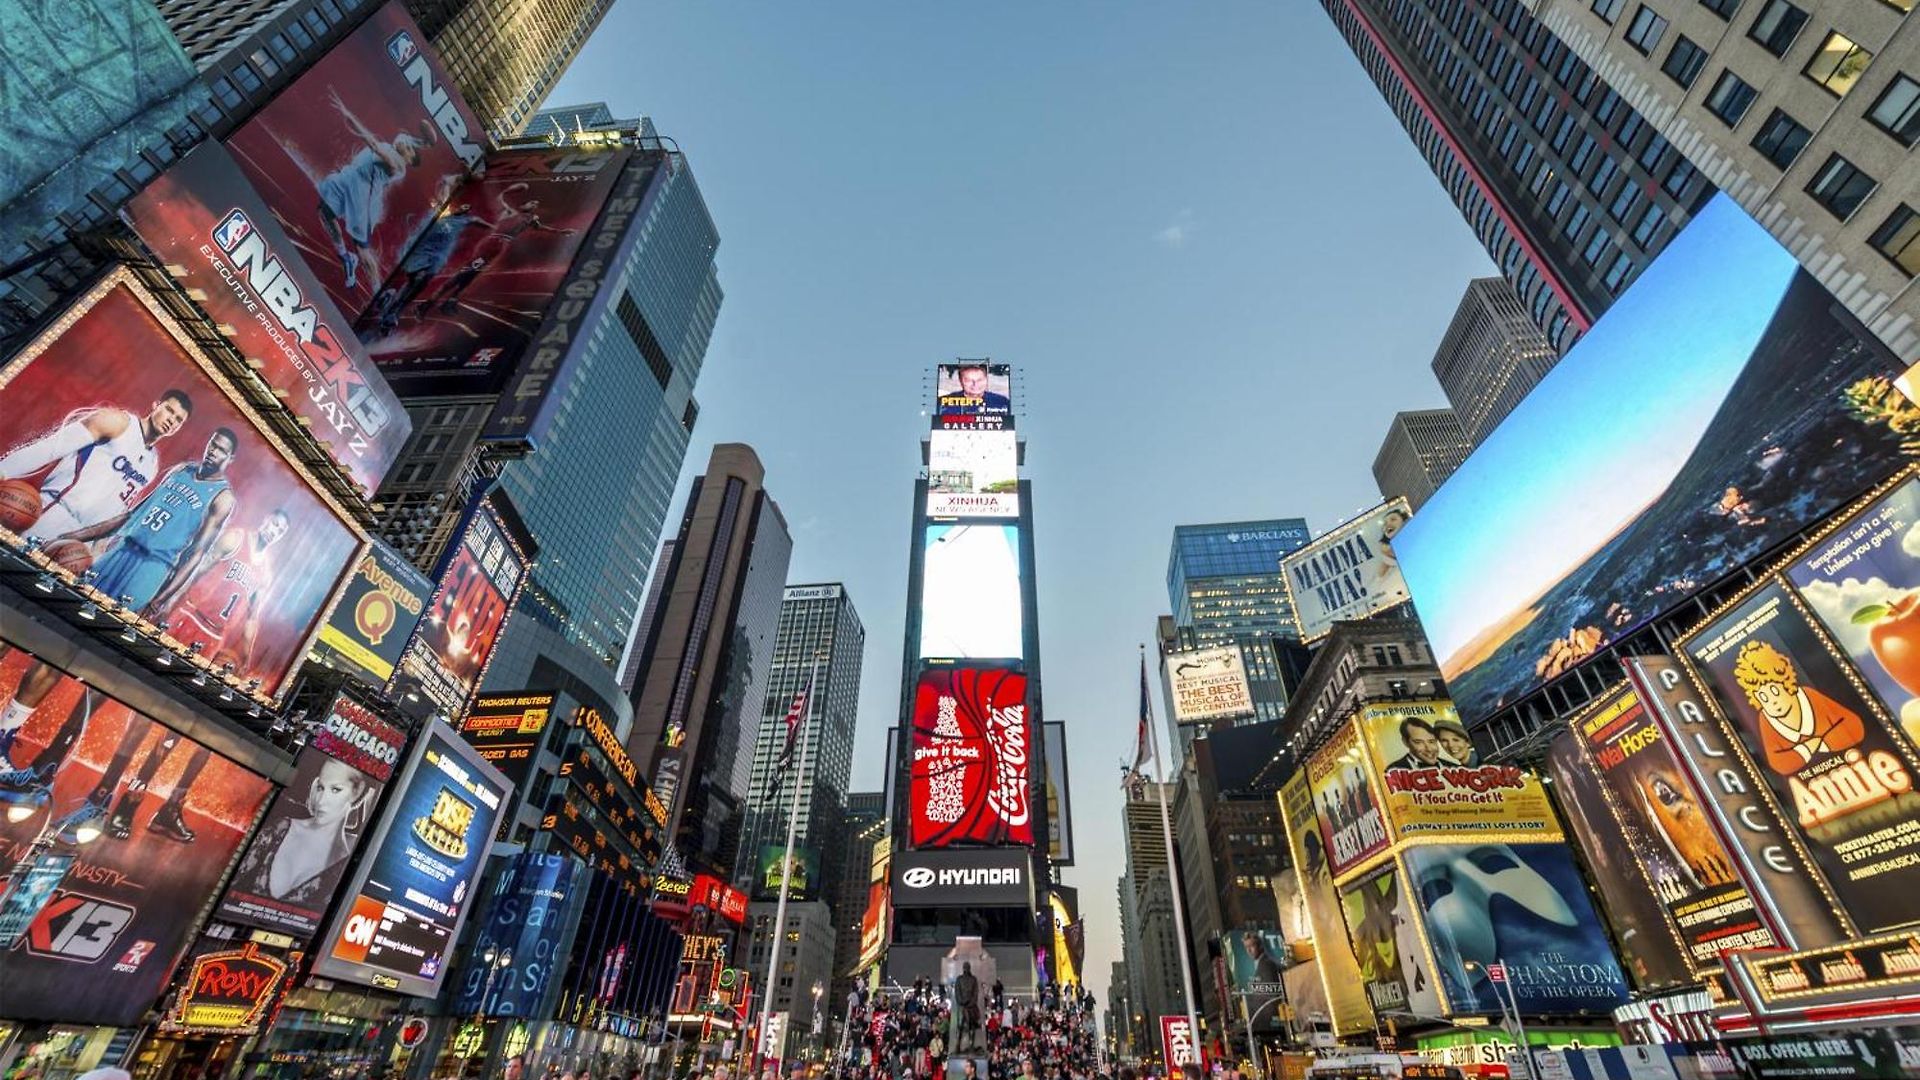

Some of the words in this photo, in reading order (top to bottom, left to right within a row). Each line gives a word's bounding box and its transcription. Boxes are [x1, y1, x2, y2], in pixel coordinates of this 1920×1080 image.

[595, 166, 654, 249] TIMES
[230, 230, 318, 343] NBA
[200, 244, 257, 313] EXECUTIVE
[255, 313, 304, 371] PRODUCED
[302, 370, 317, 382] BY
[514, 259, 604, 397] SQUARE
[941, 396, 975, 406] PETER
[309, 384, 351, 434] JAY
[348, 435, 368, 458] Z
[948, 497, 999, 506] XINHUA
[141, 507, 172, 533] 35
[1242, 528, 1302, 542] BARCLAYS
[1806, 537, 1853, 571] Temptation
[1851, 523, 1872, 541] isn't
[1292, 531, 1374, 595] MAMMA
[1823, 554, 1854, 577] Unless
[1852, 542, 1871, 561] you
[1871, 527, 1893, 549] give
[359, 555, 422, 615] Avenue
[789, 588, 820, 598] Allianz
[1316, 568, 1368, 616] MIA!
[355, 590, 396, 646] Q
[1176, 681, 1203, 690] BEST
[1207, 675, 1241, 686] MUSICAL
[1178, 689, 1206, 700] THE
[1210, 682, 1243, 697] BEST
[478, 697, 516, 708] THOMSON
[516, 696, 552, 706] REUTERS
[1180, 695, 1225, 708] MUSICAL
[1227, 691, 1245, 702] OF
[325, 713, 399, 766] CHICAGO
[1596, 745, 1625, 771] War
[1620, 722, 1660, 758] Horse
[509, 749, 529, 758] GAS
[914, 747, 938, 760] give
[941, 746, 950, 757] it
[952, 747, 979, 758] back
[1312, 762, 1335, 784] GOES
[1385, 768, 1446, 796] NICE
[1442, 765, 1526, 792] WORK
[1658, 667, 1794, 873] PALACE
[1798, 769, 1812, 781] THE
[1811, 755, 1844, 777] MUSICAL
[1413, 793, 1424, 806] If
[1424, 793, 1447, 805] You
[1446, 791, 1469, 804] Can
[1470, 792, 1492, 804] Get
[1492, 791, 1504, 803] It
[1789, 747, 1912, 827] Annie
[434, 790, 474, 839] DISH
[1494, 822, 1516, 830] LOVE
[1517, 821, 1545, 830] STORY
[1331, 821, 1364, 867] JERSEY
[1357, 807, 1386, 848] BOYS
[70, 862, 130, 888] NASTY
[655, 875, 691, 895] Reese's
[938, 868, 1021, 886] HYUNDAI
[344, 914, 378, 947] CNN
[1691, 940, 1717, 958] LINCOLN
[1717, 932, 1743, 951] CENTER
[1541, 952, 1564, 965] THE
[1820, 958, 1867, 984] Annie
[1508, 962, 1622, 986] PHANTOM
[1769, 966, 1811, 992] Annie
[1517, 986, 1535, 998] OF
[1539, 986, 1569, 998] THE
[1569, 985, 1618, 998] OPERA
[1169, 1020, 1193, 1067] tkts
[1450, 1043, 1475, 1065] sbarro
[1744, 1046, 1772, 1060] BOX
[1771, 1041, 1816, 1059] OFFICE
[1814, 1039, 1855, 1057] HERE
